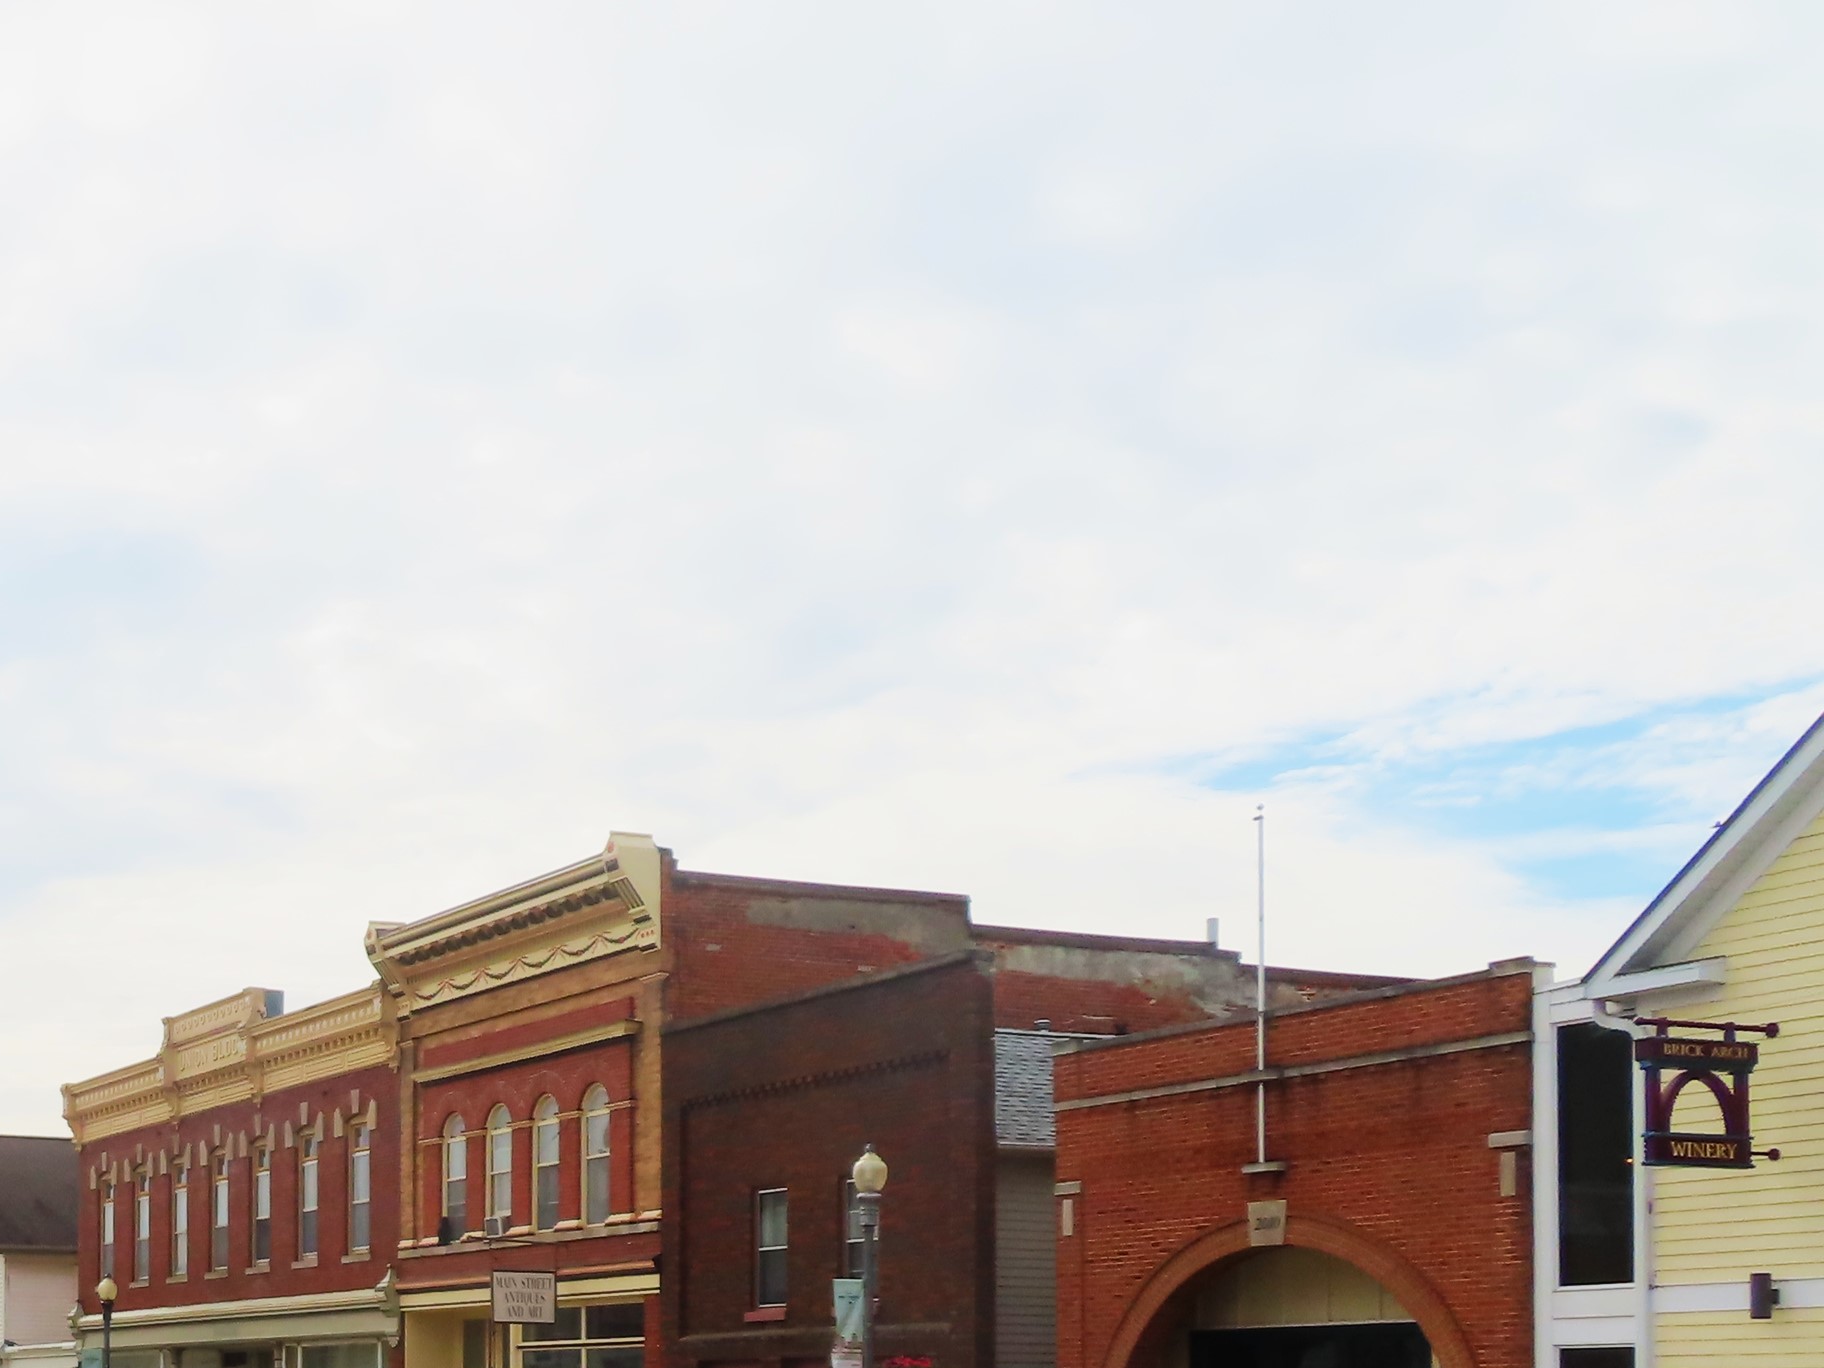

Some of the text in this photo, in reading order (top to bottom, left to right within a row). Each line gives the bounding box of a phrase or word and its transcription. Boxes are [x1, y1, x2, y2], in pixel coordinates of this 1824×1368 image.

[1662, 1043, 1749, 1059] BRICK ARCH
[1670, 1141, 1737, 1159] WINERY
[496, 1277, 552, 1290] MAIN STREET
[504, 1291, 545, 1305] ANTIQUES
[508, 1305, 543, 1318] AND ART
